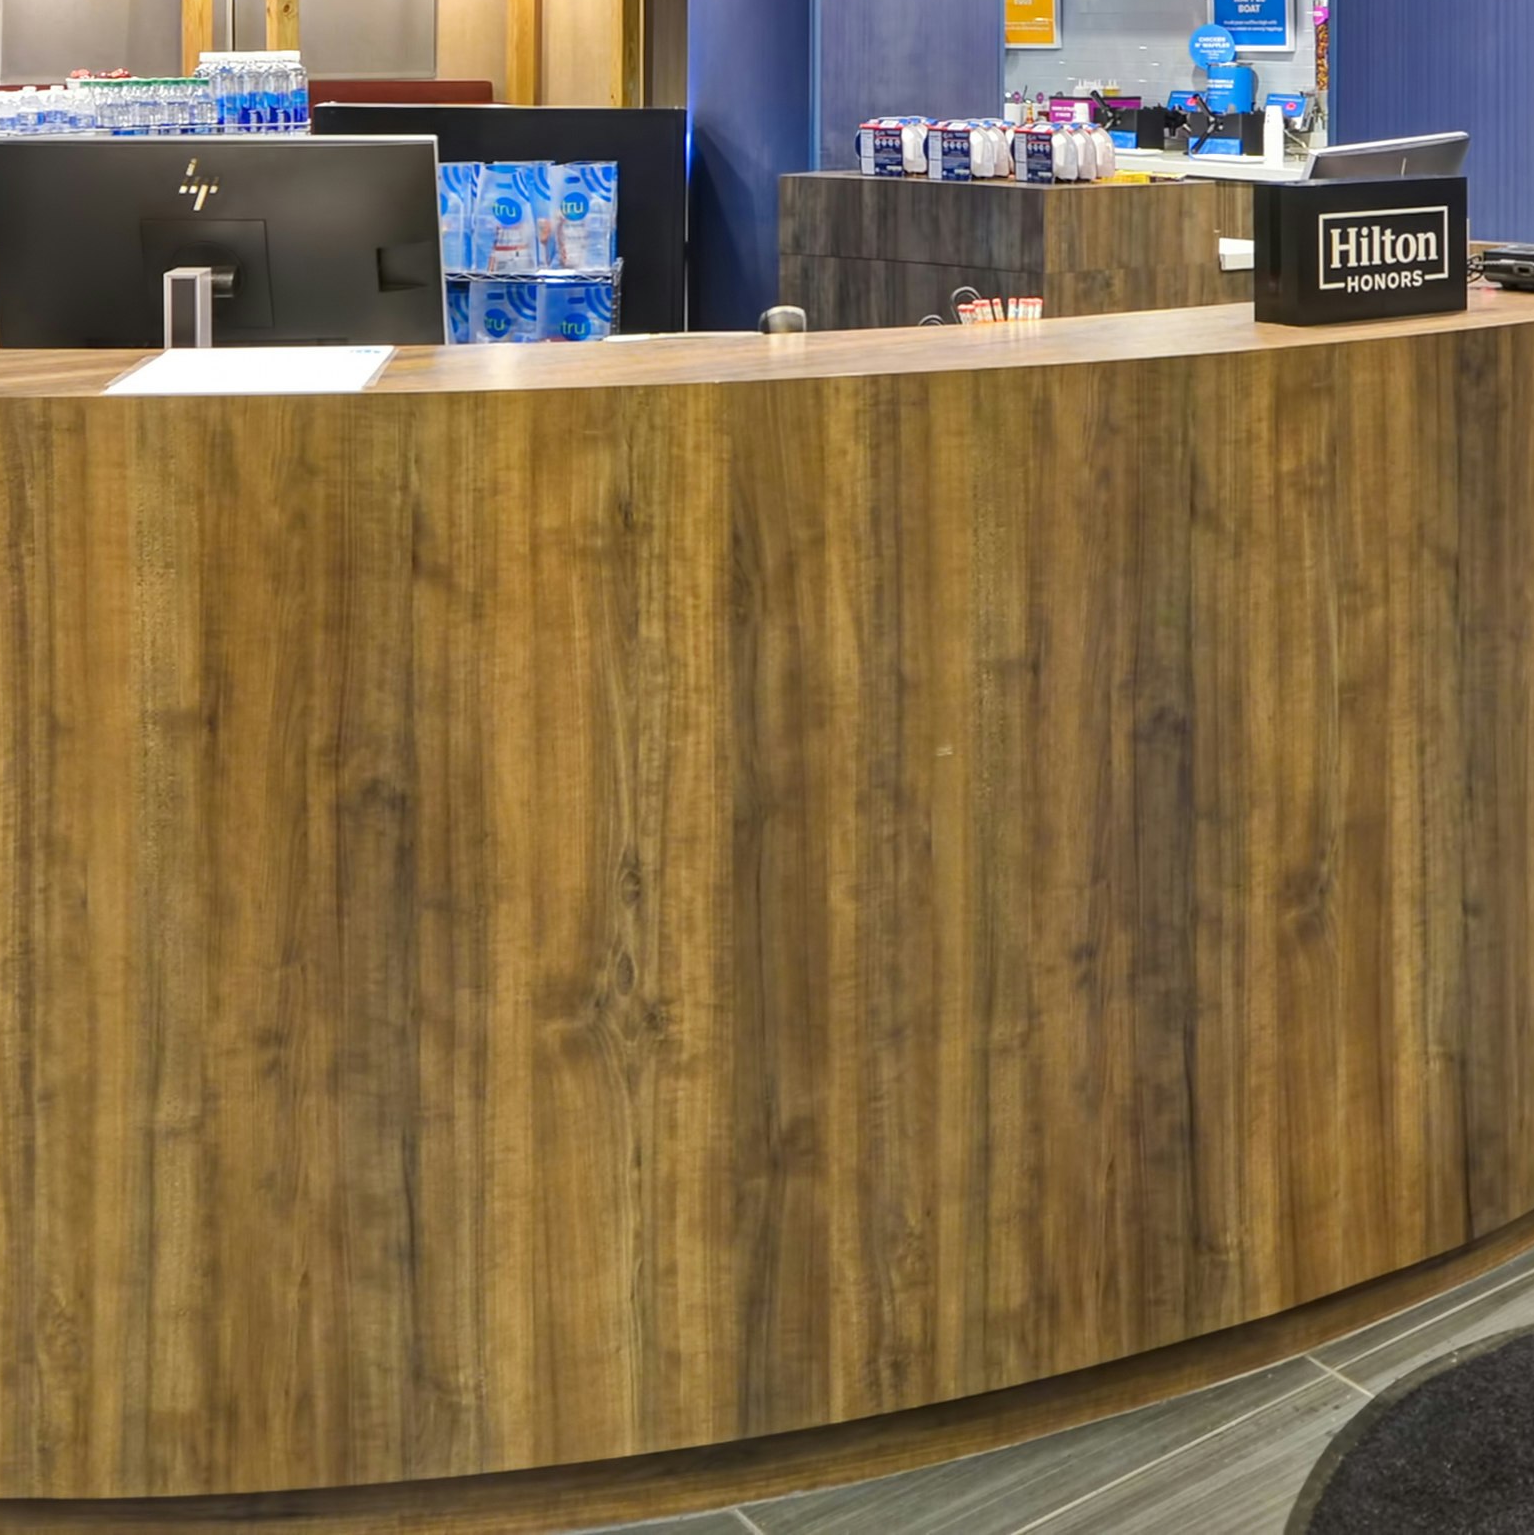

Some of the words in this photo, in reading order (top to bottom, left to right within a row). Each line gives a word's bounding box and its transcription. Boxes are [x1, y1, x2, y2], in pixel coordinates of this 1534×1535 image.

[493, 203, 516, 217] tru
[562, 199, 584, 213] tru
[1330, 225, 1438, 268] Hilton
[1347, 270, 1423, 293] HONORS
[562, 320, 586, 335] tru
